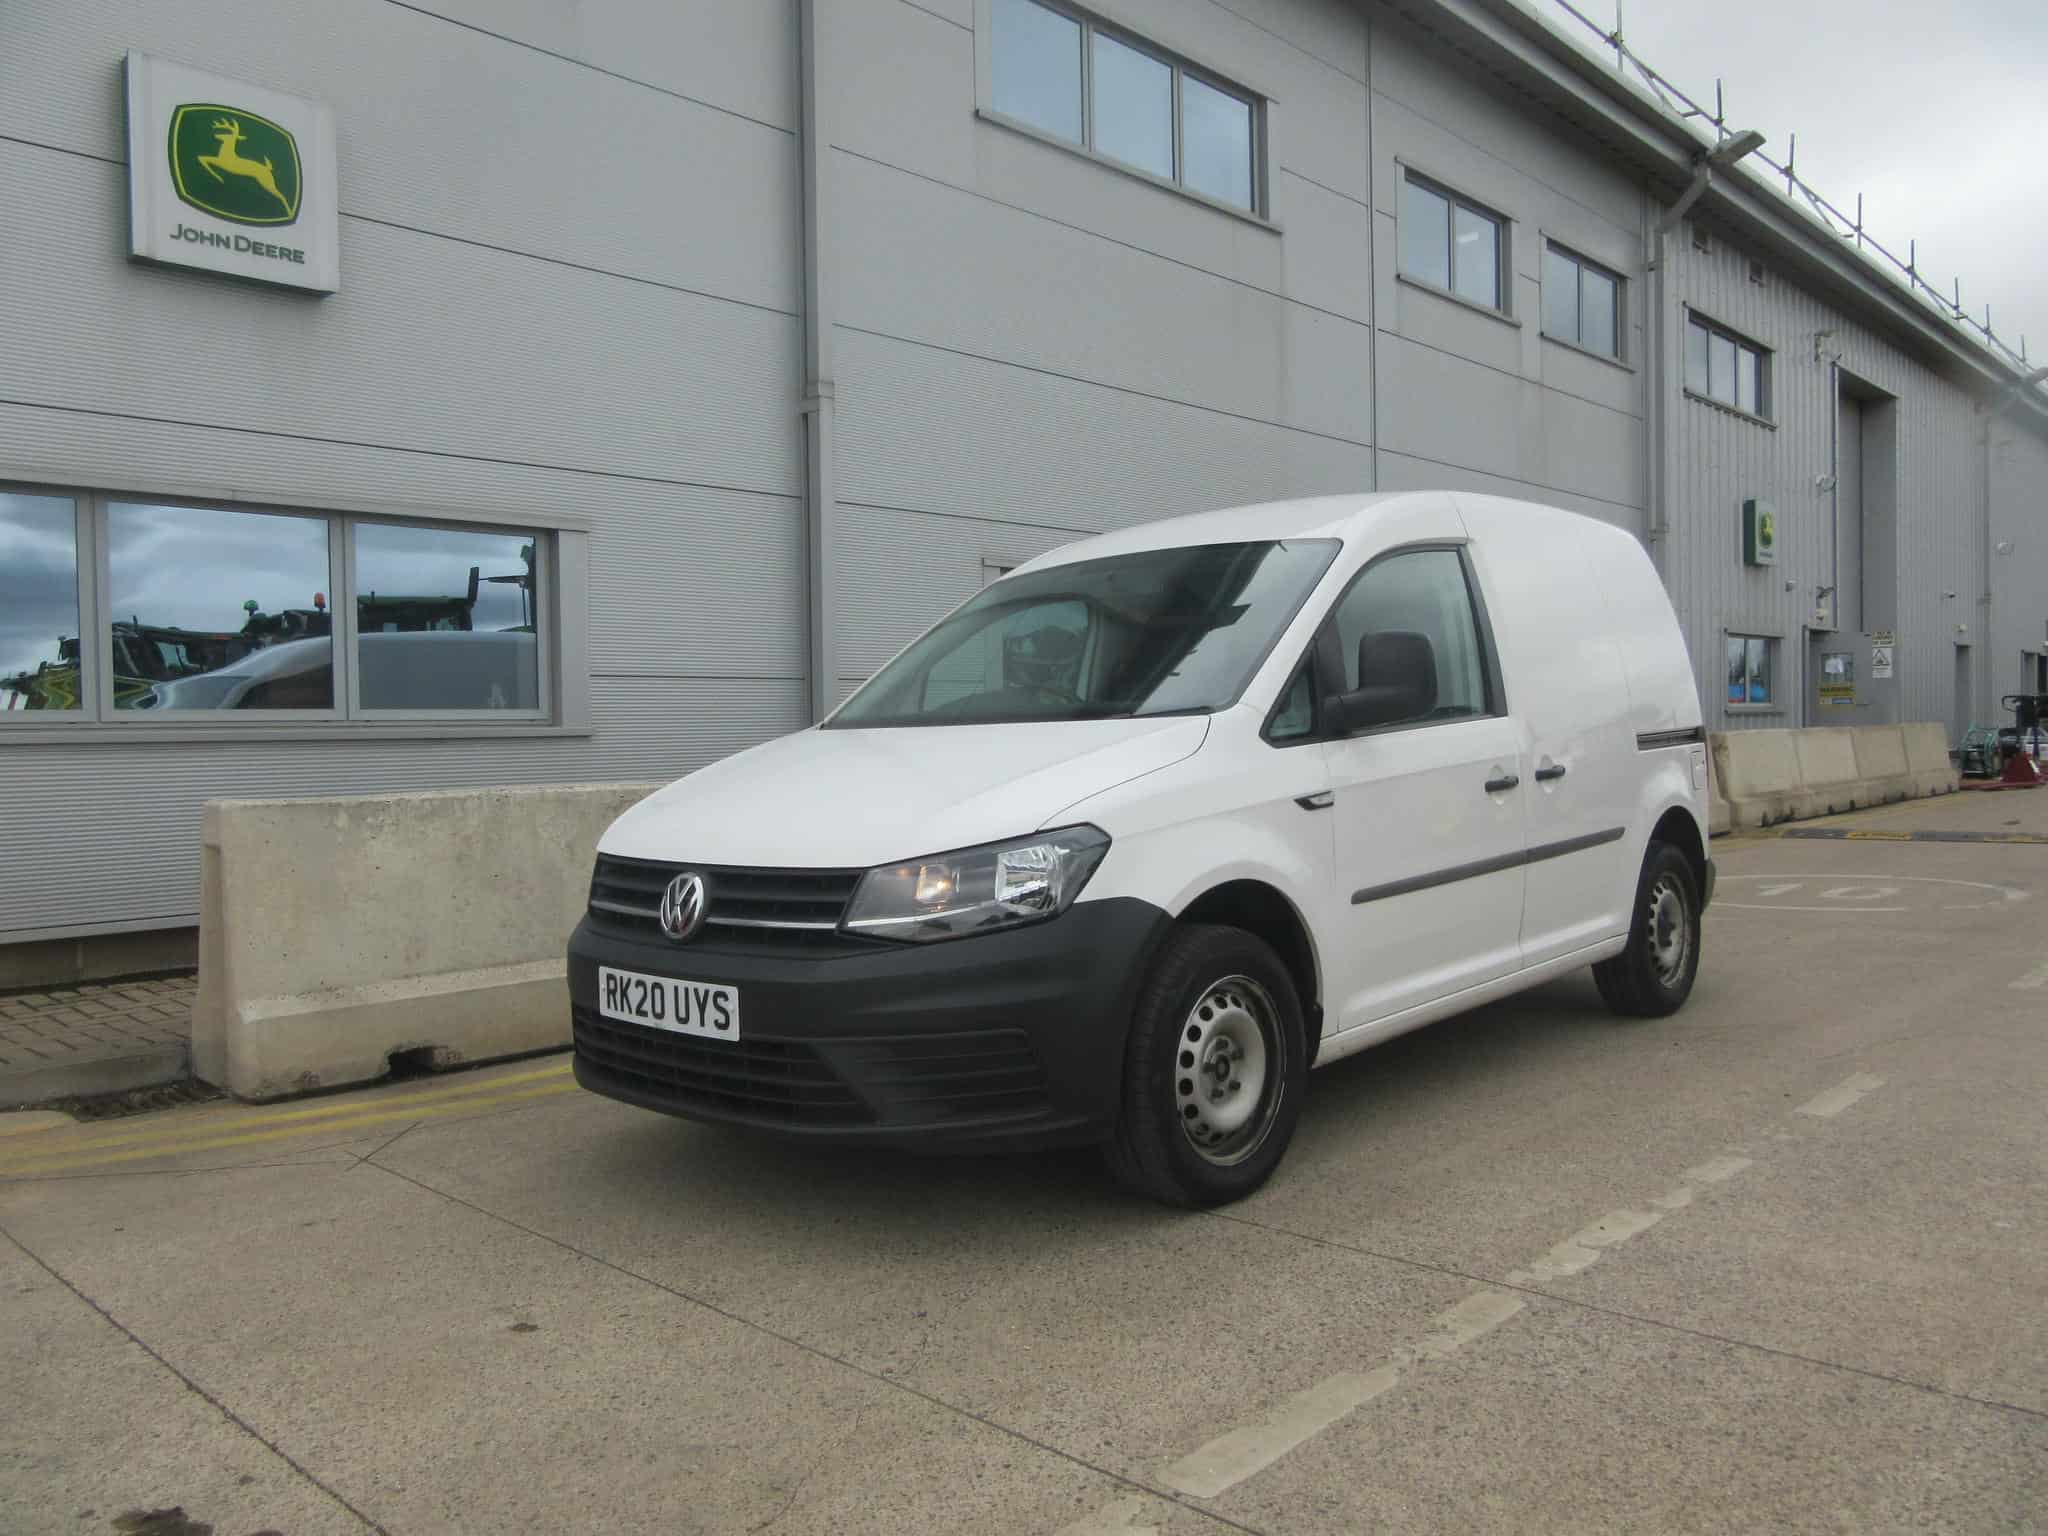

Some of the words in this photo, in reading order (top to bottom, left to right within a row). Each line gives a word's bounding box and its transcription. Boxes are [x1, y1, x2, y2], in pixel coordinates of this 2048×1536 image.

[170, 223, 231, 250] JOHN
[234, 235, 305, 264] DEERE
[606, 973, 665, 1020] RK20
[674, 985, 730, 1031] UYS
